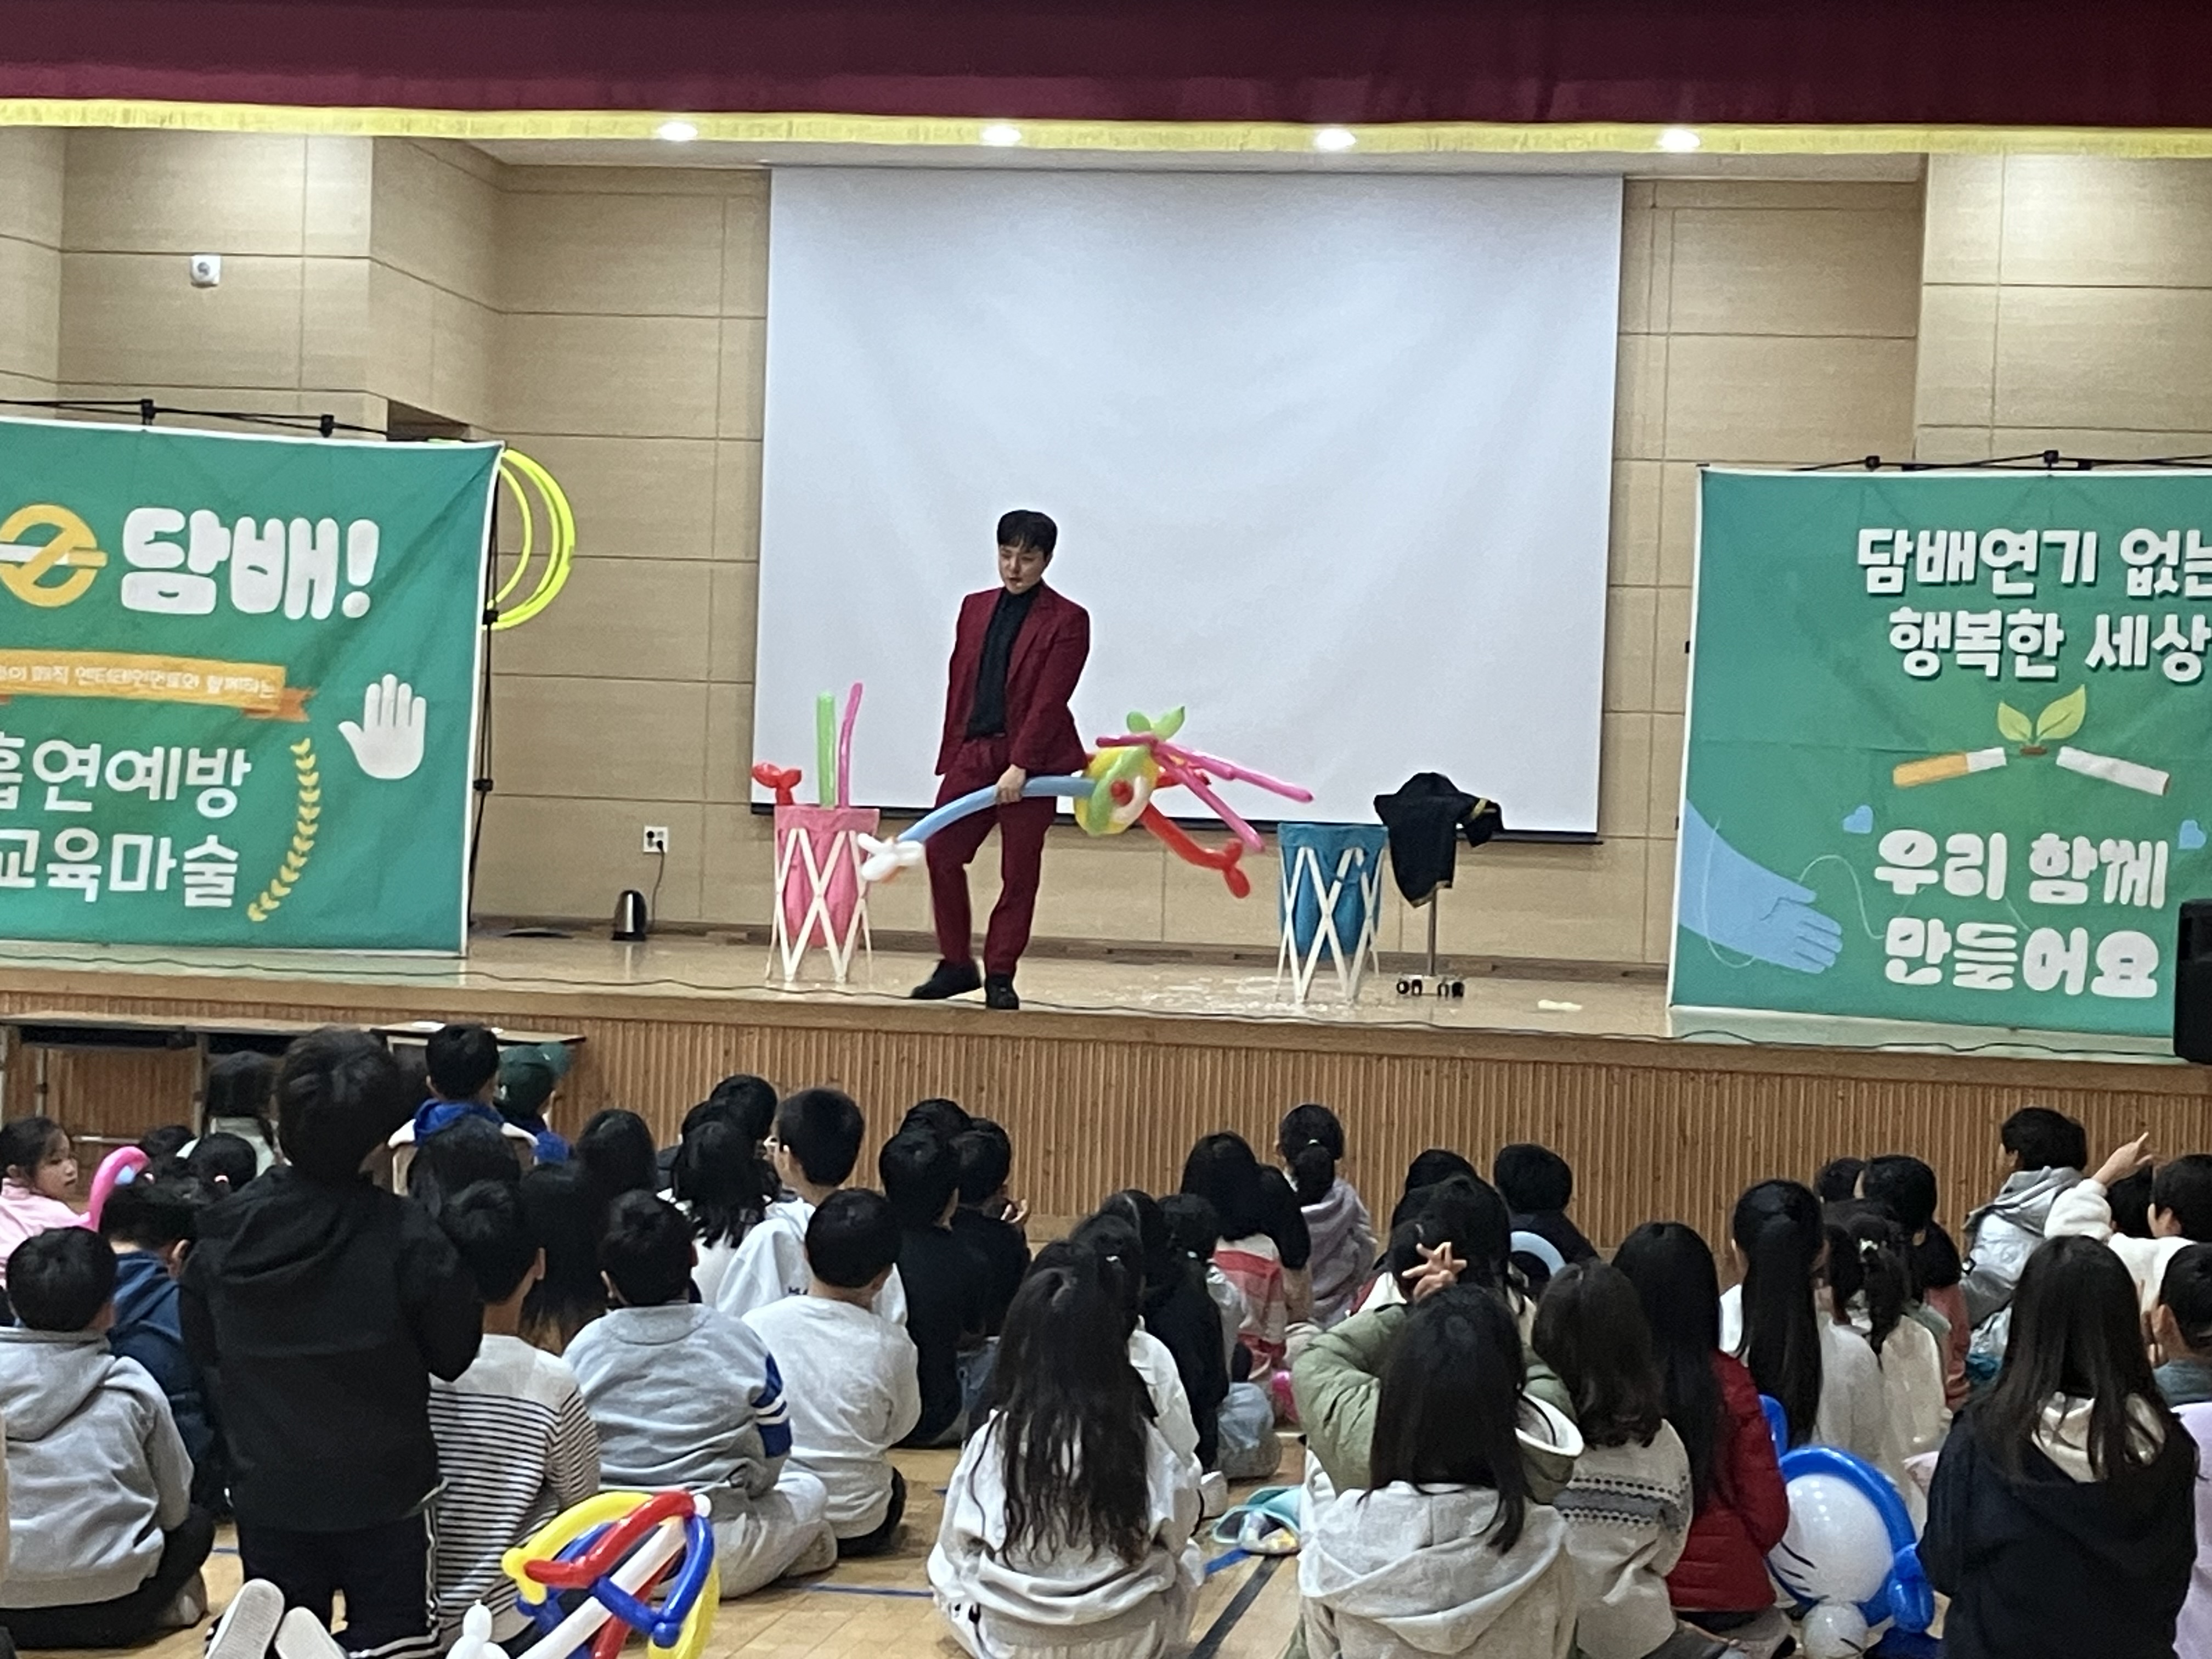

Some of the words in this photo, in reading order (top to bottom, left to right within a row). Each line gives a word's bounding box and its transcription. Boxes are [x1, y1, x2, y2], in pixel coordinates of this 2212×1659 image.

[121, 507, 380, 620] 담배!
[1858, 528, 2098, 596] 담배연기
[1889, 606, 2065, 678] 행복한
[2084, 613, 2212, 682] 세상
[0, 827, 239, 908] 교육마술
[1874, 828, 2007, 901] 우리
[2029, 832, 2169, 909] 함께
[1884, 916, 2160, 998] 만들어요
